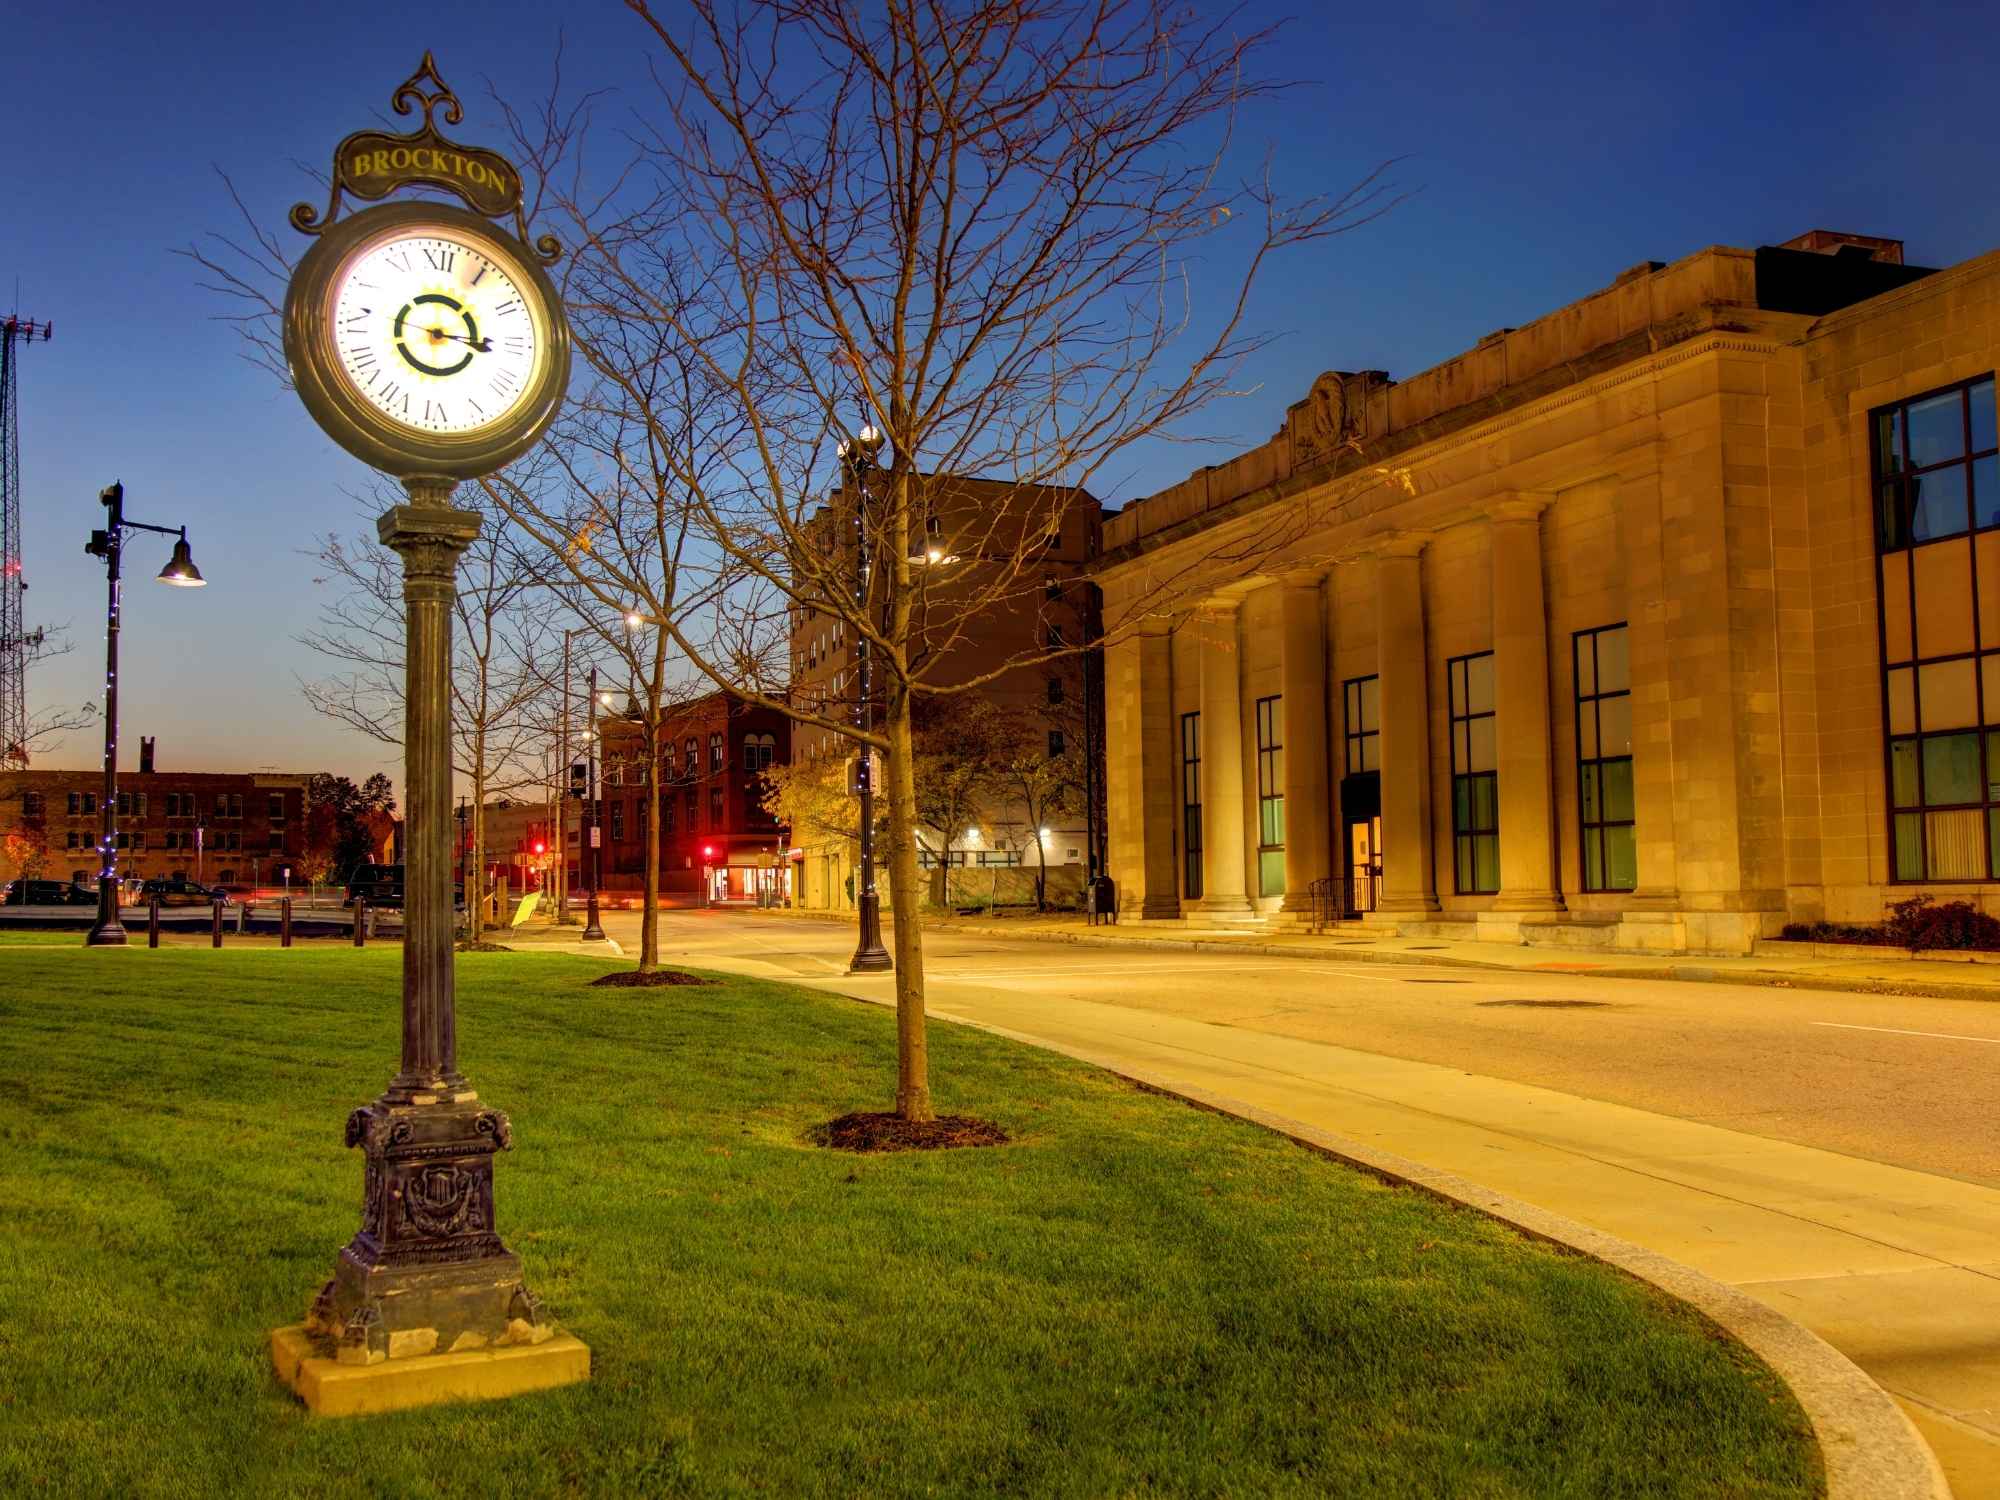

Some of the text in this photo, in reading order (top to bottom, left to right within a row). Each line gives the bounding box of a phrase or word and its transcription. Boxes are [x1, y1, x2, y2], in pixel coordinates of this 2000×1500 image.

[355, 148, 506, 195] BROCKTON
[422, 249, 454, 273] XII
[495, 300, 517, 316] II
[424, 399, 448, 422] VI
